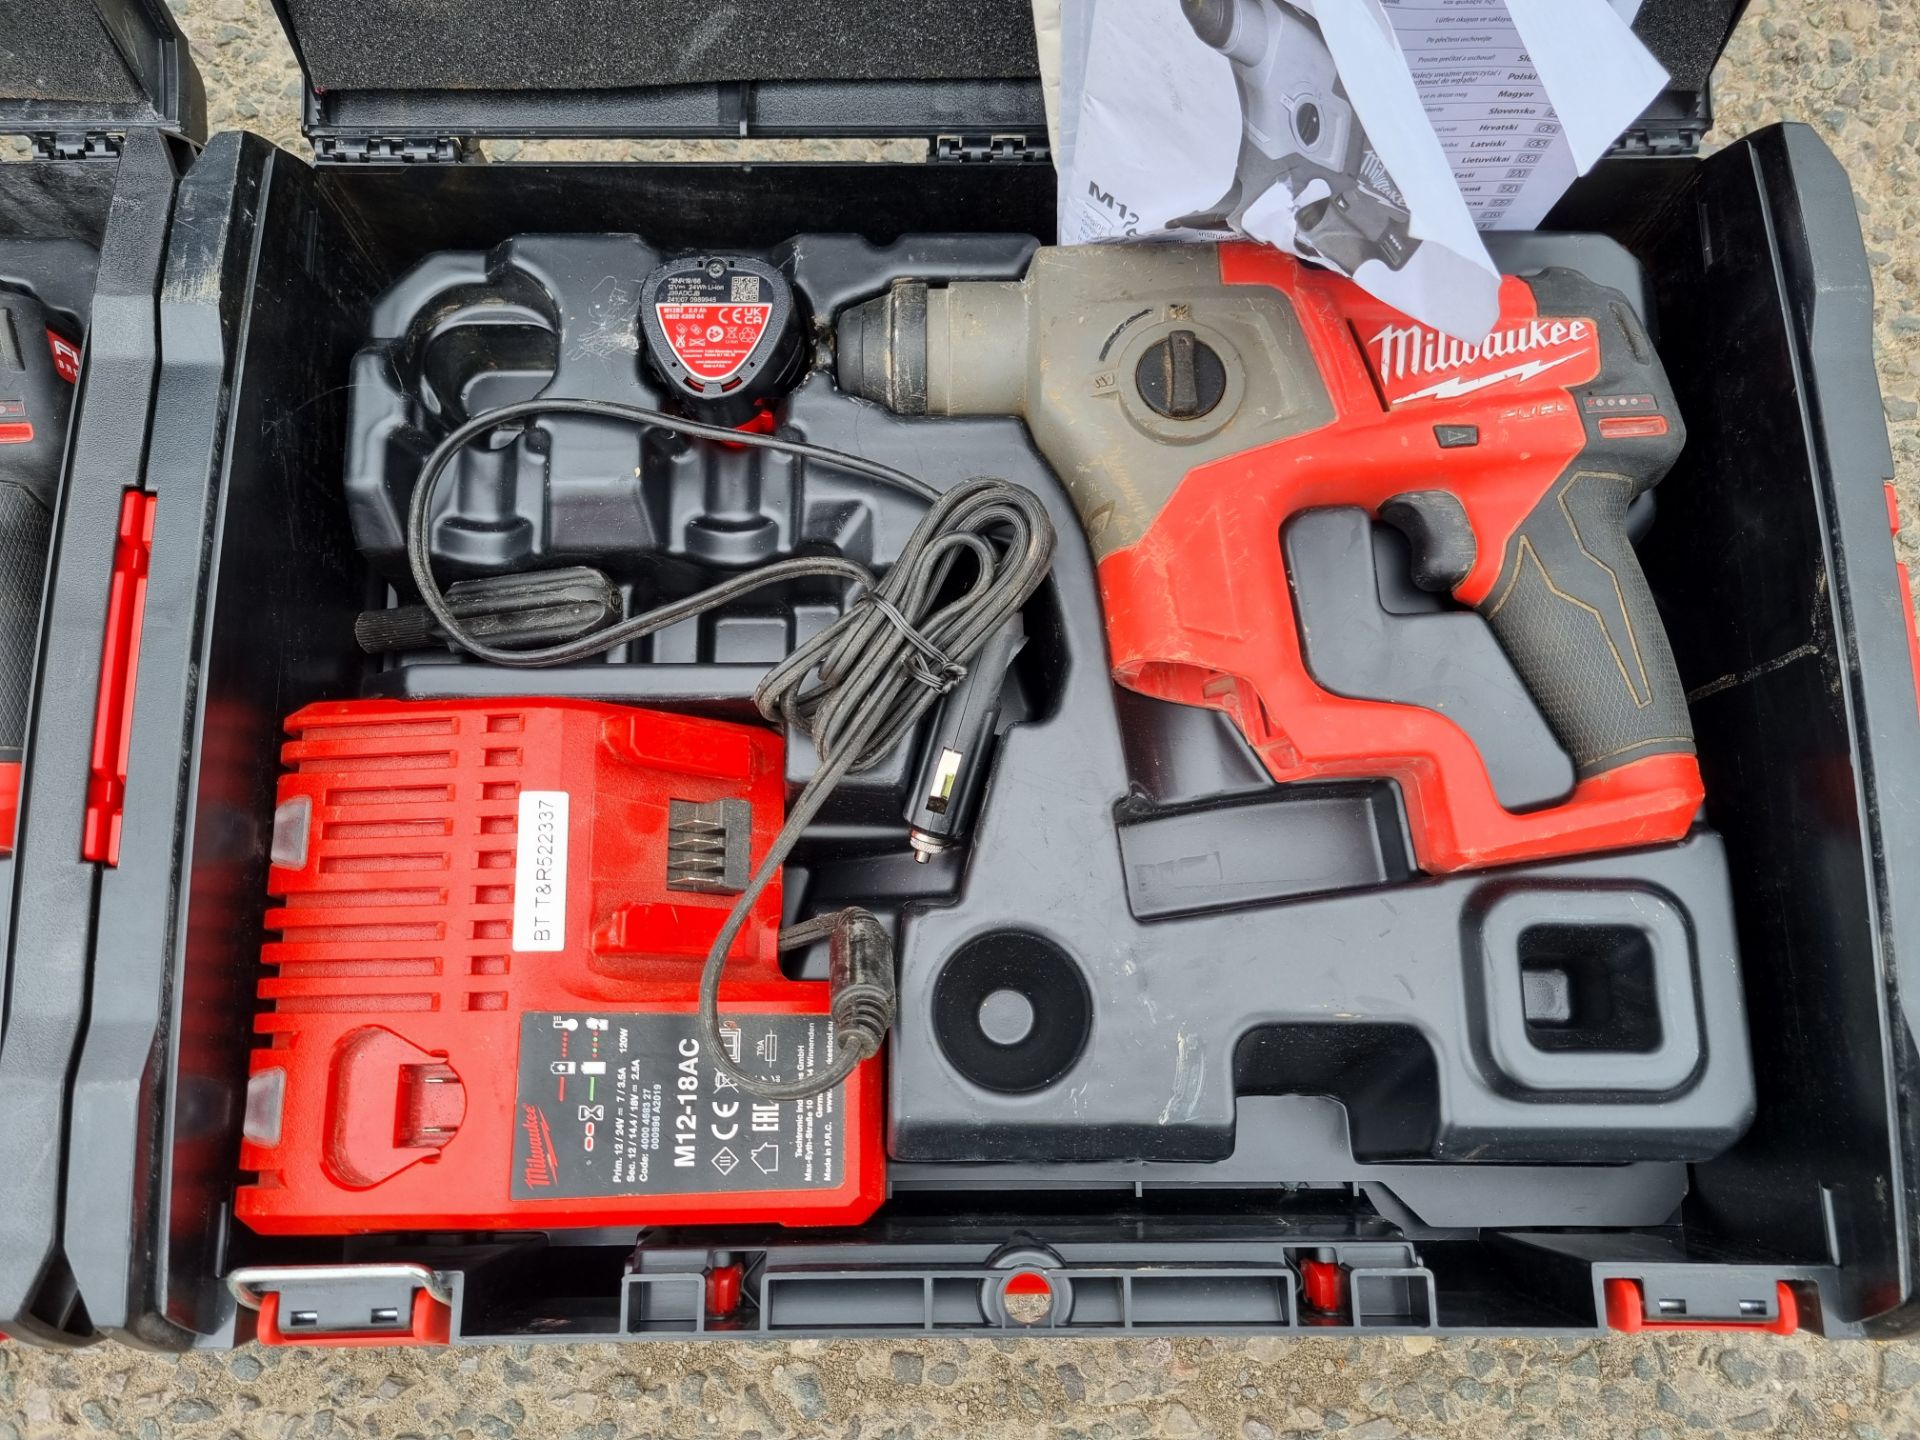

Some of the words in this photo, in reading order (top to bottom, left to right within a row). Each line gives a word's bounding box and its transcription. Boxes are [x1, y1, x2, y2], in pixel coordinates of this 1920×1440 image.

[1508, 73, 1537, 81] Polski
[1498, 90, 1534, 98] Magyar
[1488, 107, 1536, 115] Slovensko
[1470, 139, 1506, 148] Latviski
[1462, 155, 1511, 164] Lietuviškai
[718, 308, 742, 324] CE
[744, 316, 762, 324] CA
[1368, 320, 1590, 387] Milwaukee
[535, 800, 555, 909] T&R522337
[533, 916, 550, 941] BT
[619, 1028, 628, 1053] 120W
[756, 1039, 765, 1056] T9A
[807, 1022, 815, 1067] Winnenden
[631, 1059, 640, 1080] 2.5A
[630, 1094, 639, 1112] 18V
[642, 1088, 652, 1100] 27
[652, 1084, 662, 1113] A2019
[673, 1038, 700, 1167] M12-18AC
[805, 1100, 813, 1109] 10
[615, 1118, 624, 1136] 24V
[711, 1101, 739, 1140] CE
[752, 1103, 780, 1131] EAC
[628, 1120, 638, 1139] 14.4
[641, 1126, 650, 1150] 4000
[824, 1122, 832, 1146] P.R.C.
[523, 1105, 550, 1190] Milwaukee
[614, 1143, 624, 1155] 12
[627, 1147, 637, 1158] 12
[824, 1147, 832, 1156] in
[612, 1157, 623, 1183] Prim.
[626, 1161, 636, 1182] Sec.
[639, 1153, 649, 1182] Code:
[824, 1158, 832, 1181] Made
